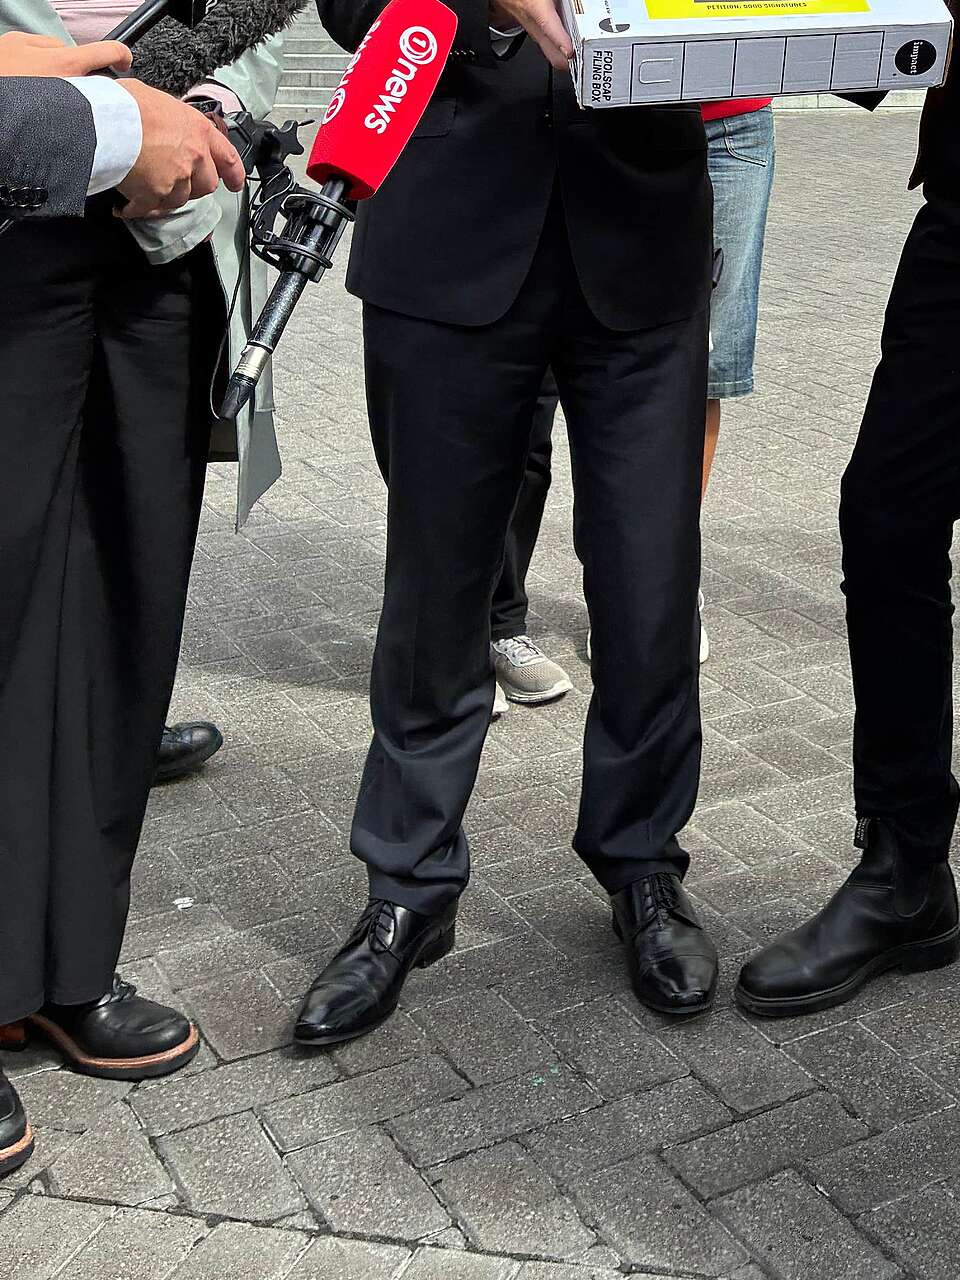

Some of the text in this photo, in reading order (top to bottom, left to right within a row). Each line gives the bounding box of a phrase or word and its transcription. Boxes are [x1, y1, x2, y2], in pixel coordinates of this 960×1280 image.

[591, 50, 603, 103] FILING BOX
[602, 50, 613, 102] FOOLSCAP
[910, 41, 923, 74] impact
